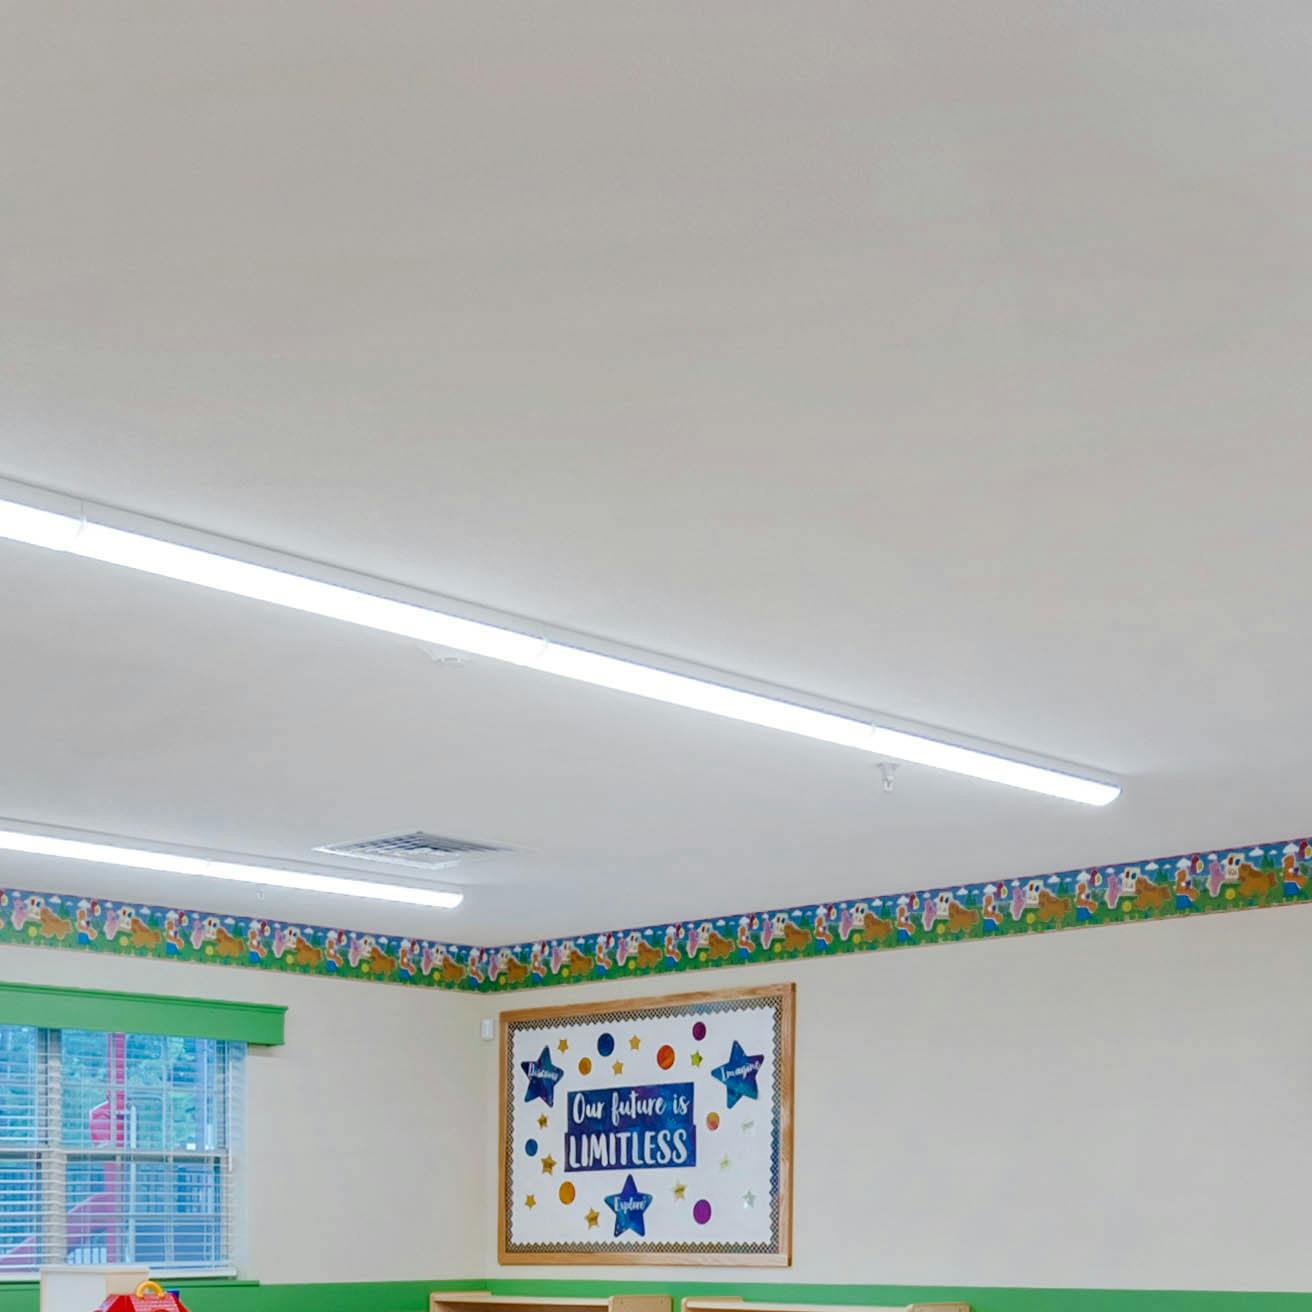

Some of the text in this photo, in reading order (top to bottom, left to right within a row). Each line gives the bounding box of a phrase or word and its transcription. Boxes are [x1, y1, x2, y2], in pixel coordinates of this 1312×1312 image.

[720, 1060, 761, 1082] Imagine
[572, 1091, 691, 1126] Our future is
[568, 1128, 688, 1169] LIMITLESS
[613, 1196, 647, 1215] Explore
